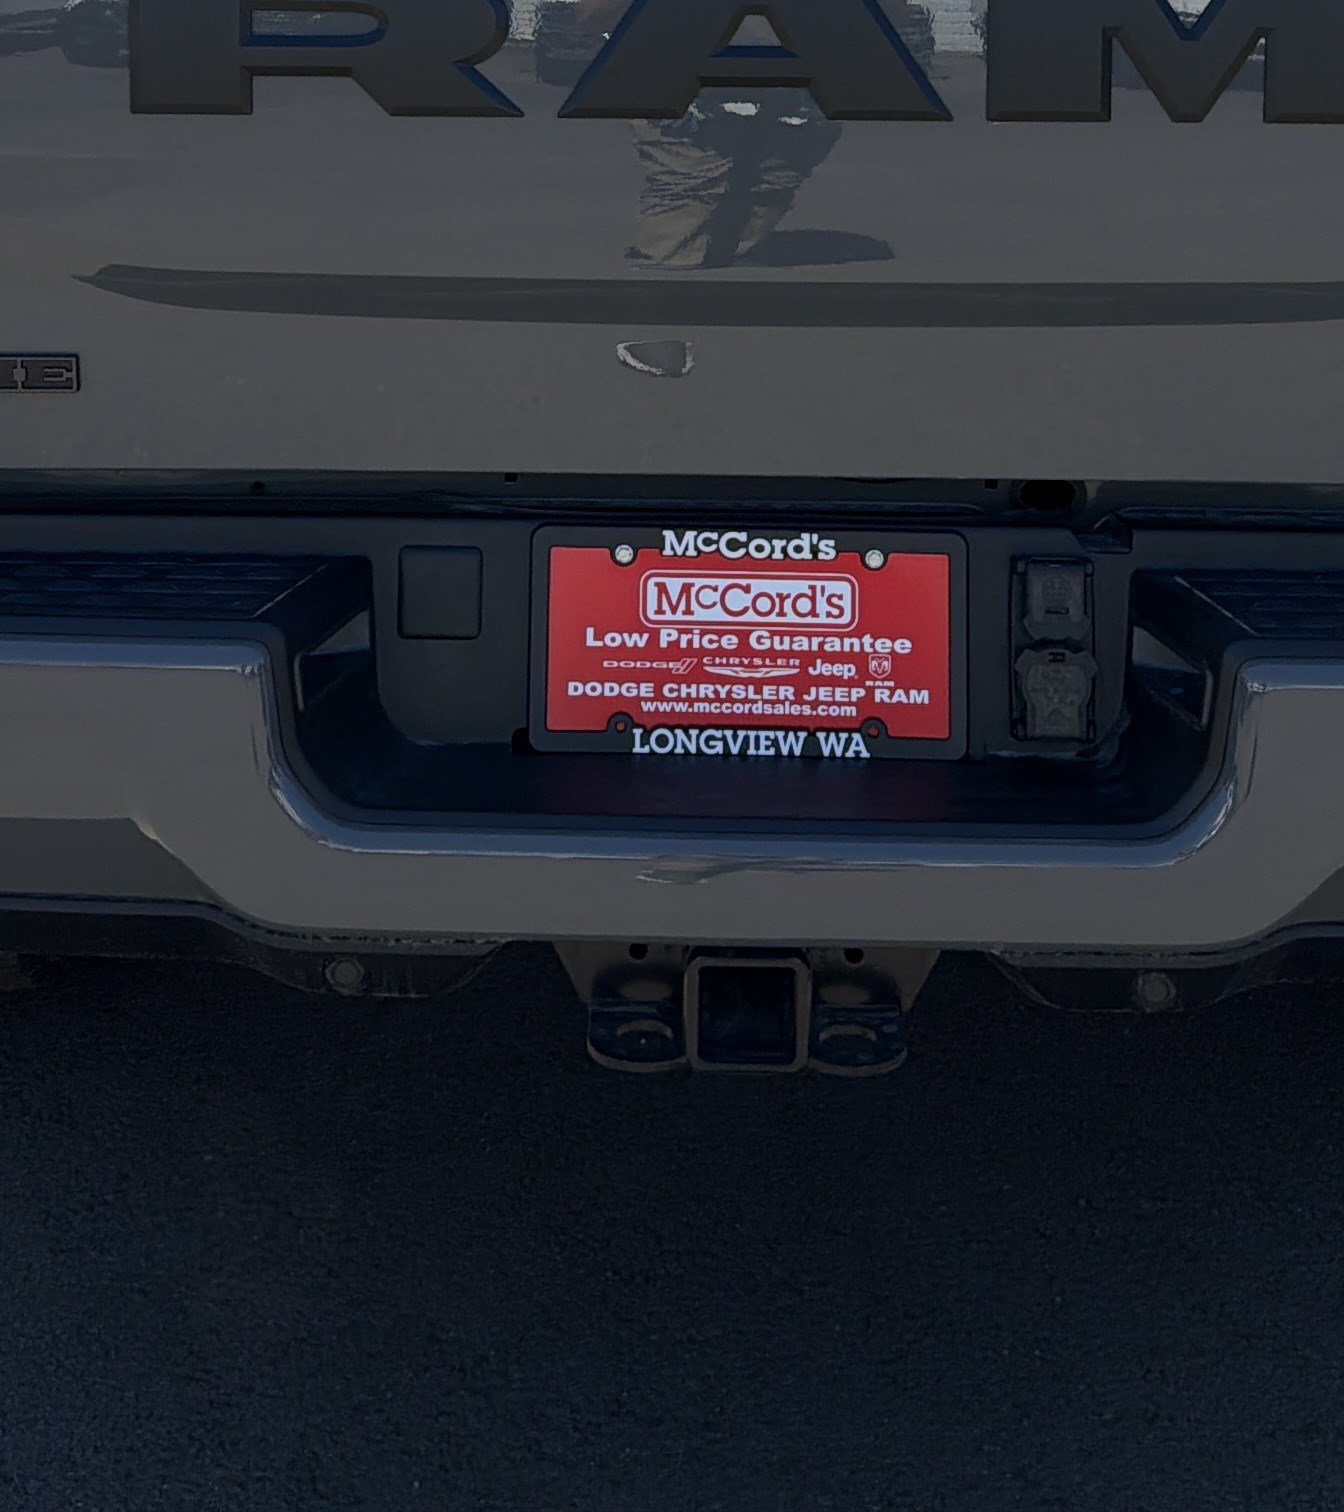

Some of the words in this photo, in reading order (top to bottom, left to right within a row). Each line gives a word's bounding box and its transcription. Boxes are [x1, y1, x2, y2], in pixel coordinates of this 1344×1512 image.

[662, 529, 837, 561] McCord's
[653, 582, 845, 619] McCord's
[586, 626, 649, 648] Low
[659, 628, 739, 650] Price
[749, 630, 913, 655] Guarantee
[602, 659, 681, 669] DODGE
[702, 657, 801, 666] CHRYSLER
[808, 659, 856, 680] Jeep
[567, 681, 654, 698] DODGE
[662, 683, 795, 701] CHRYSLER
[802, 686, 866, 703] JEEP
[874, 688, 930, 705] RAM
[641, 699, 857, 716] www.mccordsales.com
[632, 728, 807, 757] LONGVIEW
[816, 732, 870, 759] WA
